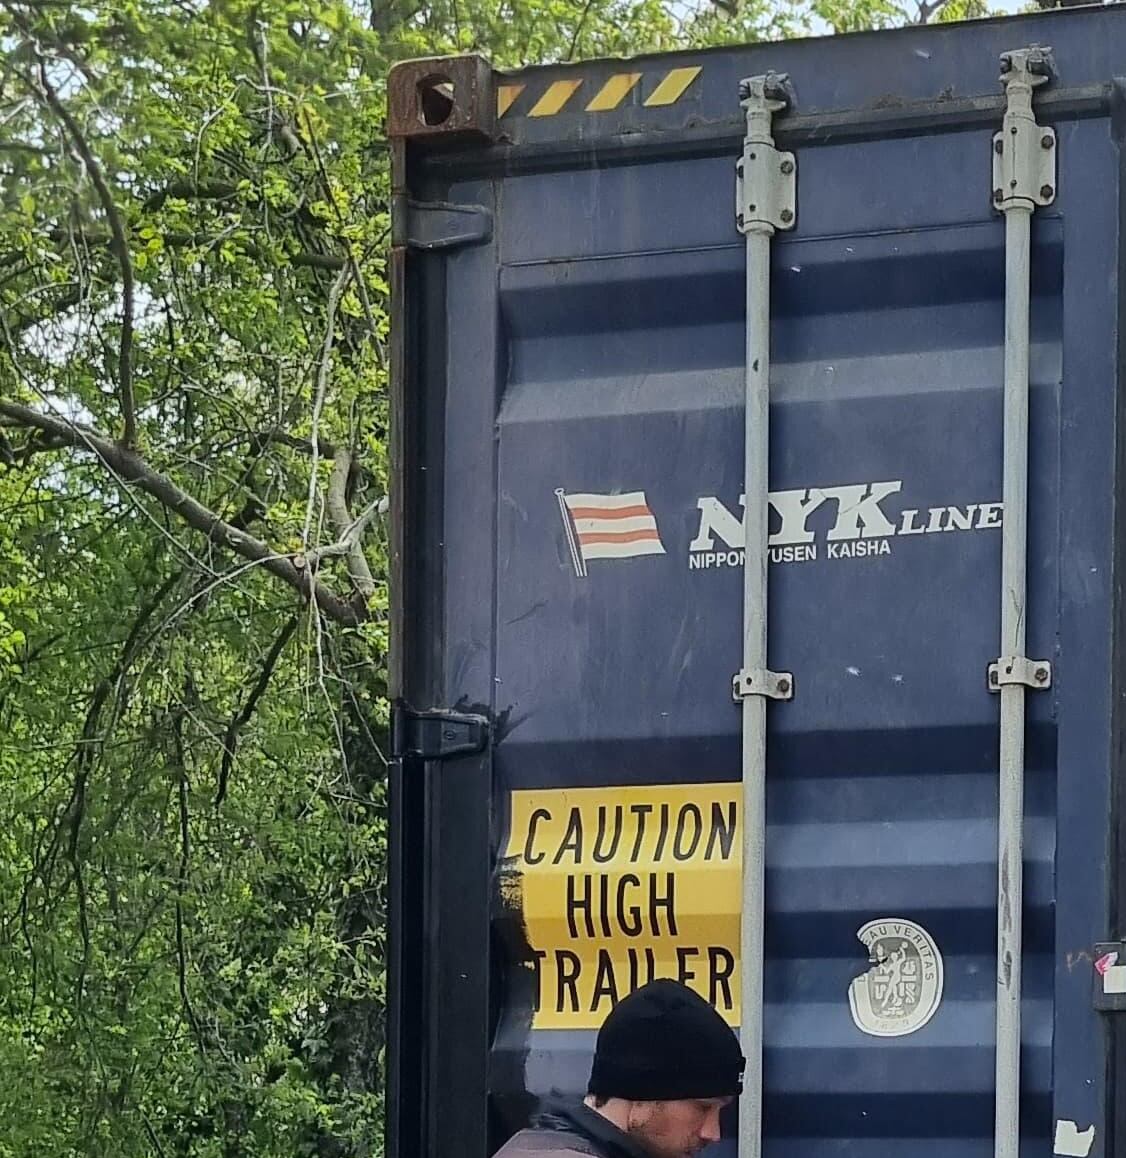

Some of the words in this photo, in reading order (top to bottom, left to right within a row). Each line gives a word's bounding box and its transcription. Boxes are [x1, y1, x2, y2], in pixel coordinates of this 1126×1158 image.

[689, 480, 902, 552] NYK
[898, 502, 1005, 535] LINE
[768, 545, 817, 563] USEN
[827, 540, 891, 559] KAISHA
[523, 801, 737, 865] CAUTION
[567, 872, 678, 938] HIGH
[893, 925, 934, 981] VERITAS
